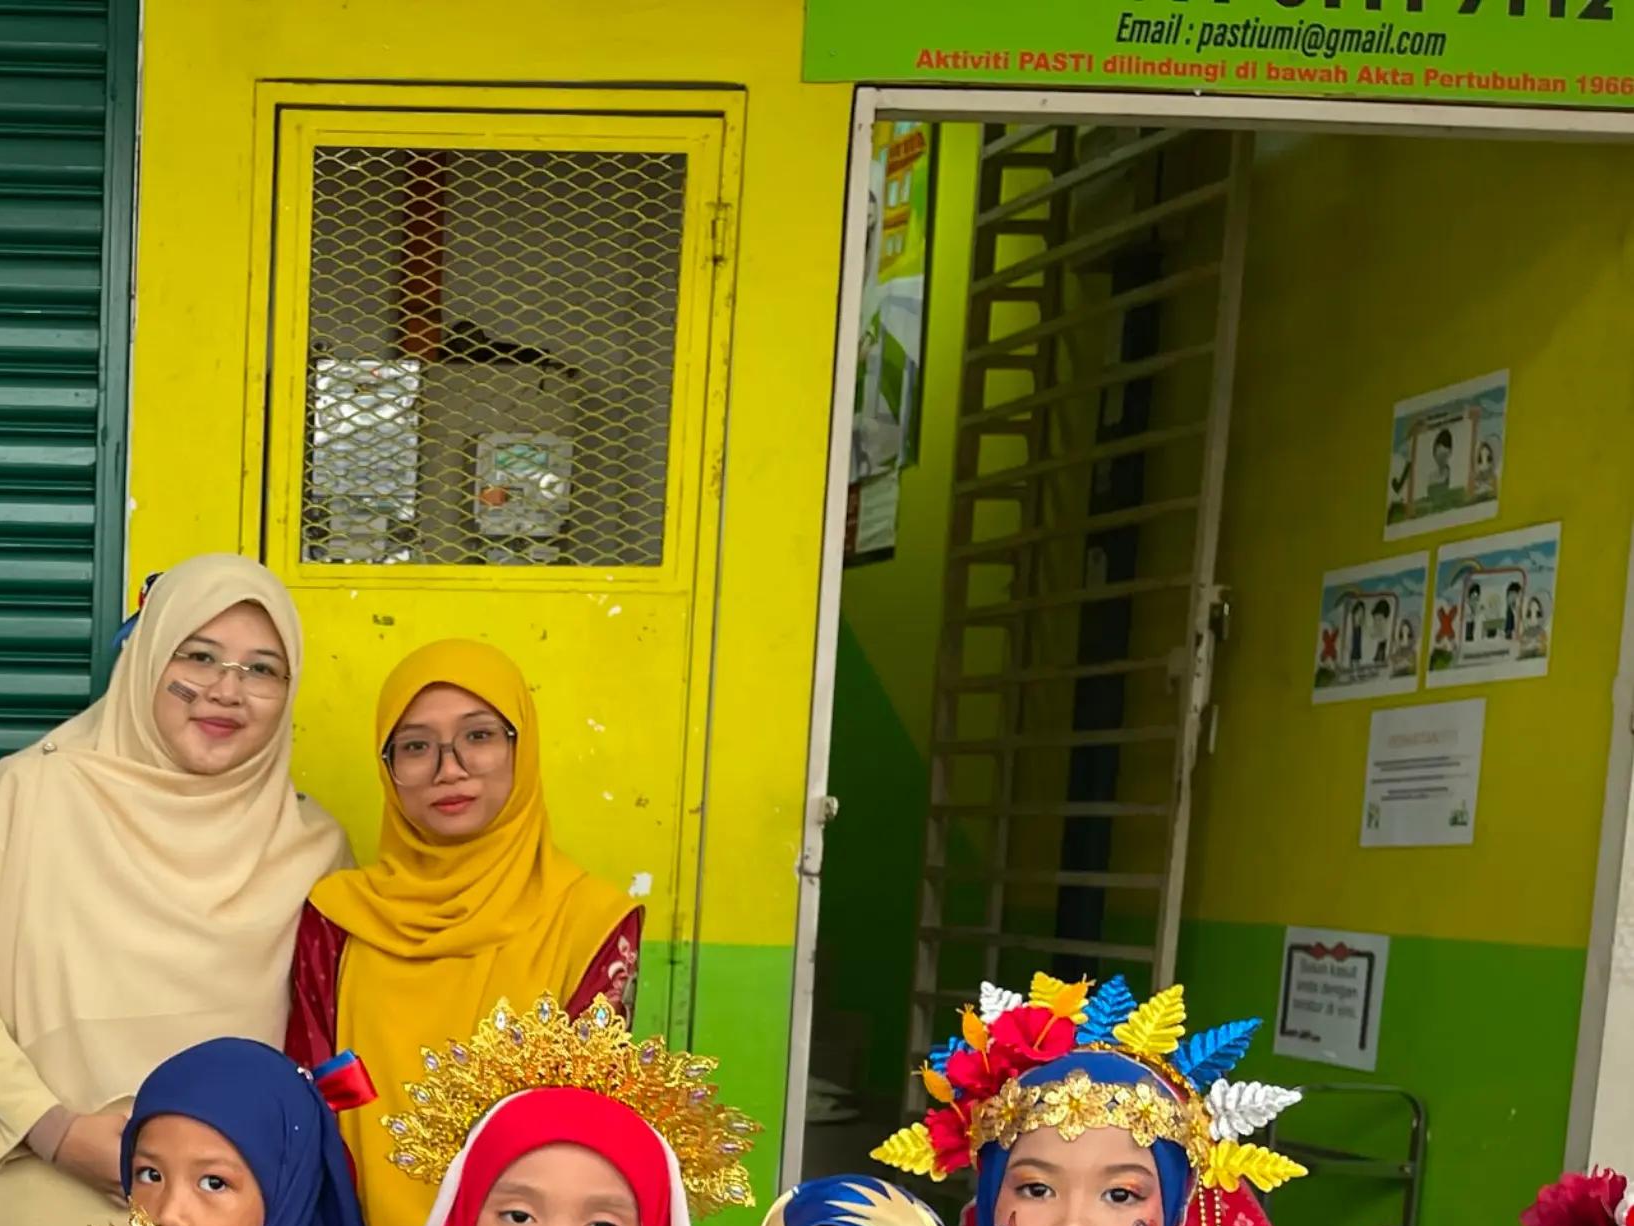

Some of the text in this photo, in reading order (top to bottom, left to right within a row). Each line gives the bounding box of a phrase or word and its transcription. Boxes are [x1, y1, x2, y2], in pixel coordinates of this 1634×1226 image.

[1116, 12, 1183, 45] Email
[1196, 17, 1447, 59] pastiumi@gmail.com
[916, 48, 1634, 96] Aktiviti PASTI dilindungi di bawah Akta Pertubuhan 1966
